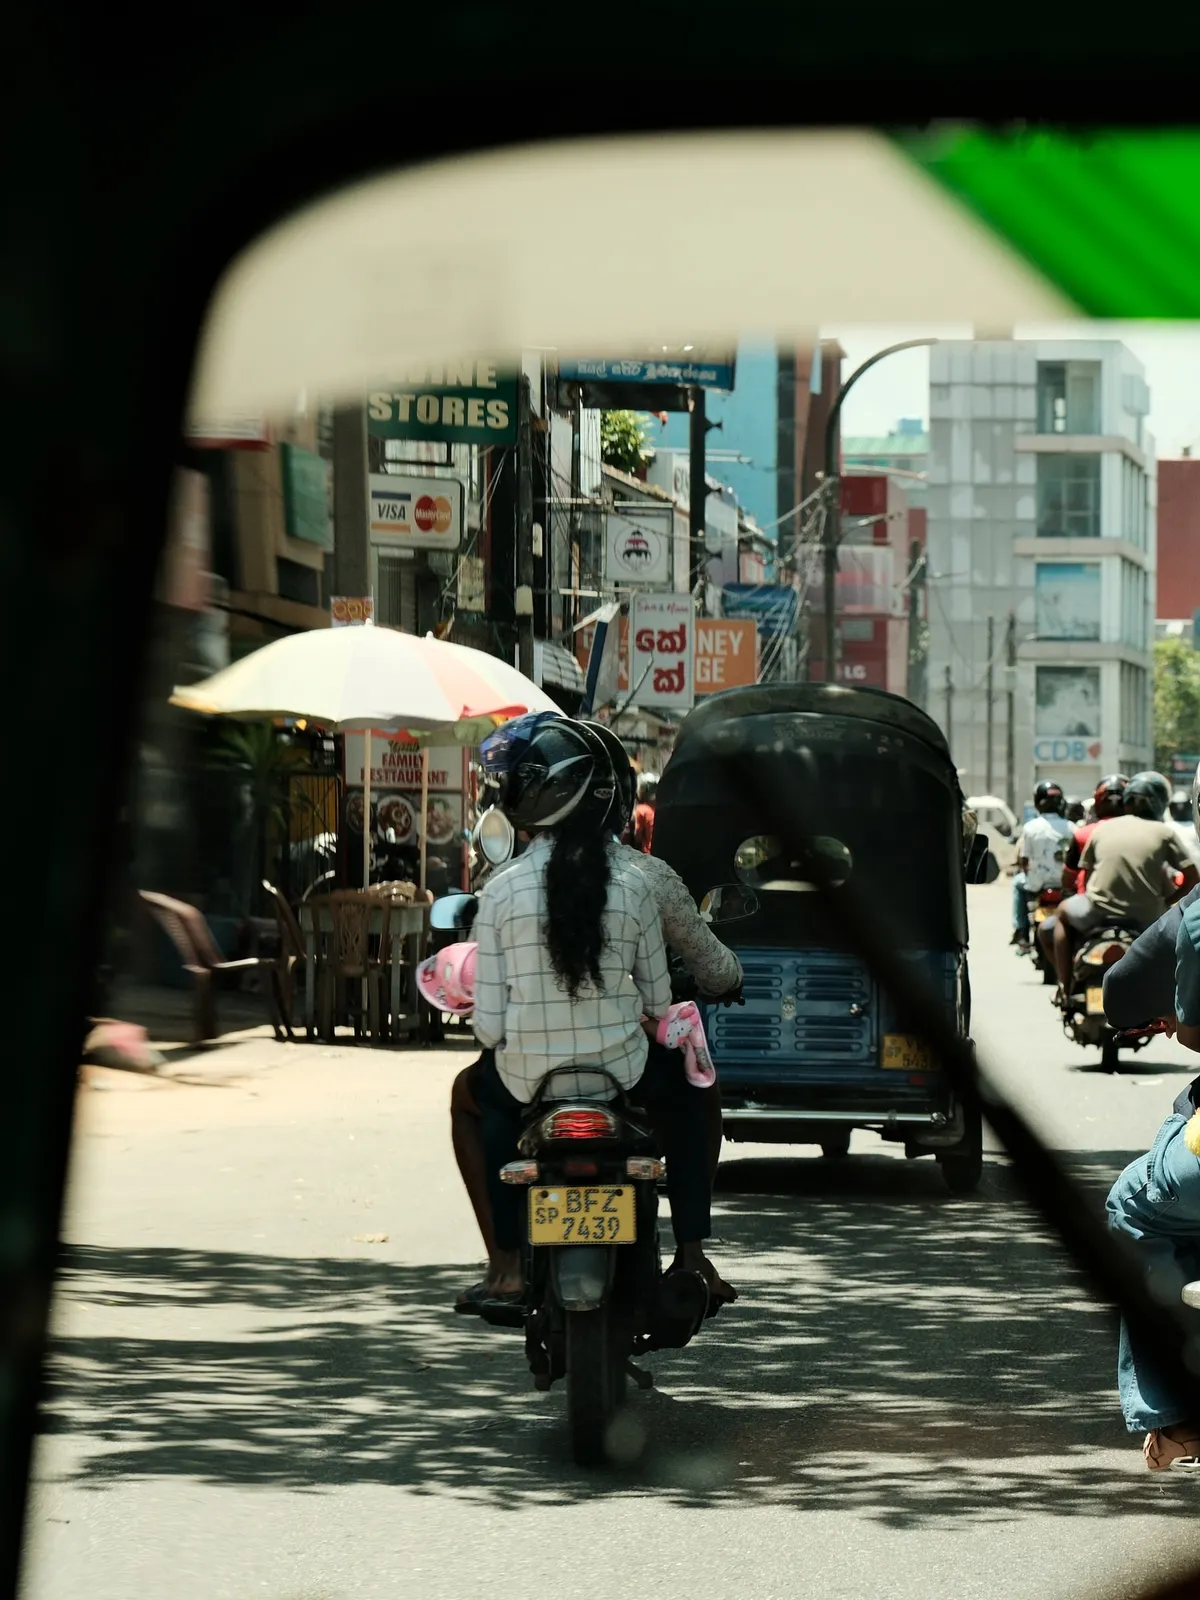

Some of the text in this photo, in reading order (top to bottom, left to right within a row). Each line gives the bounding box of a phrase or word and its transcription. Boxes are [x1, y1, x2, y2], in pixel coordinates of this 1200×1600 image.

[368, 391, 509, 430] STORES
[377, 503, 406, 521] VISA
[696, 628, 744, 656] NEY
[843, 664, 867, 680] LG
[381, 752, 424, 768] FAMILY
[1034, 740, 1086, 762] CDB
[566, 1188, 619, 1213] BFZ
[535, 1206, 559, 1225] SP
[562, 1216, 620, 1240] 7439
